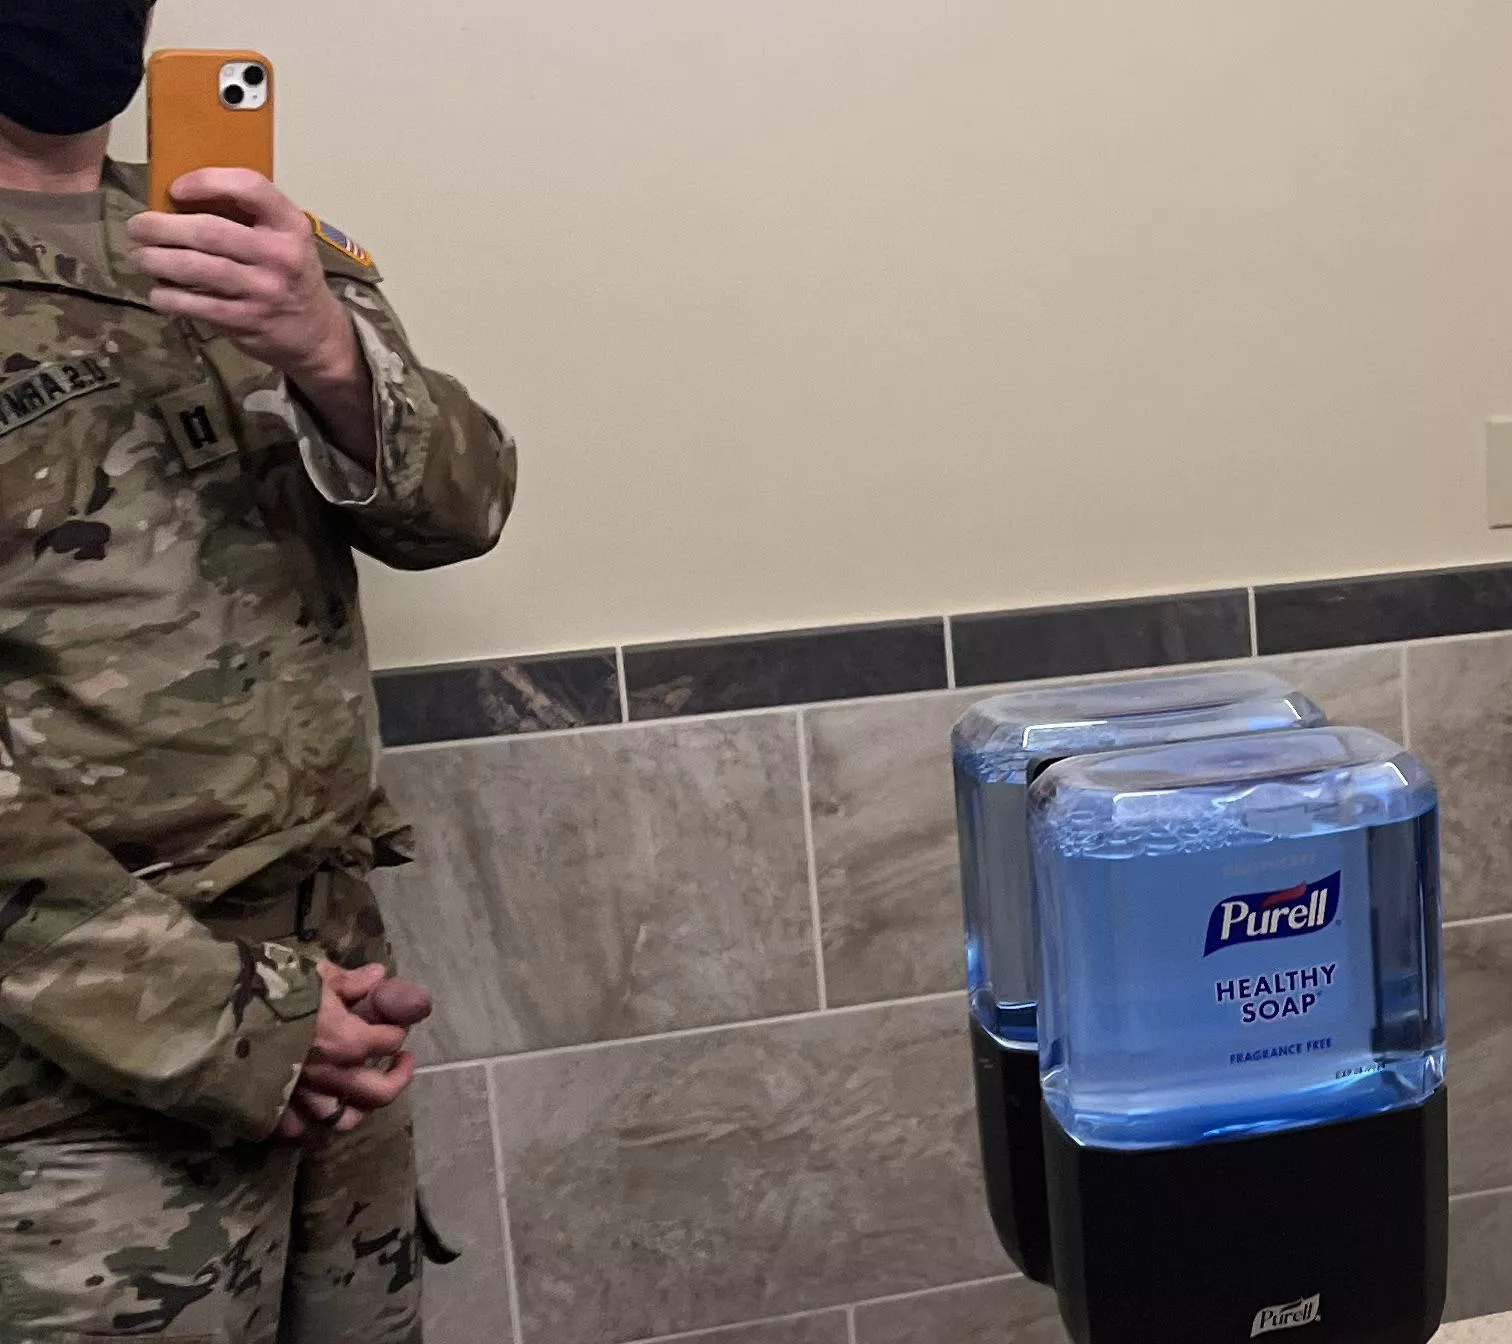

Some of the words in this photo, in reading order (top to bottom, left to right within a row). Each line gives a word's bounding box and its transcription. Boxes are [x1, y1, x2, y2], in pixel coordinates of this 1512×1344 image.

[1220, 888, 1328, 940] Purell
[1216, 963, 1336, 1001] HEALTHY
[1242, 993, 1316, 1024] SOAP
[1230, 1043, 1301, 1064] FRAGRANCE
[1306, 1037, 1332, 1053] FREE
[1259, 1302, 1313, 1328] Purell
